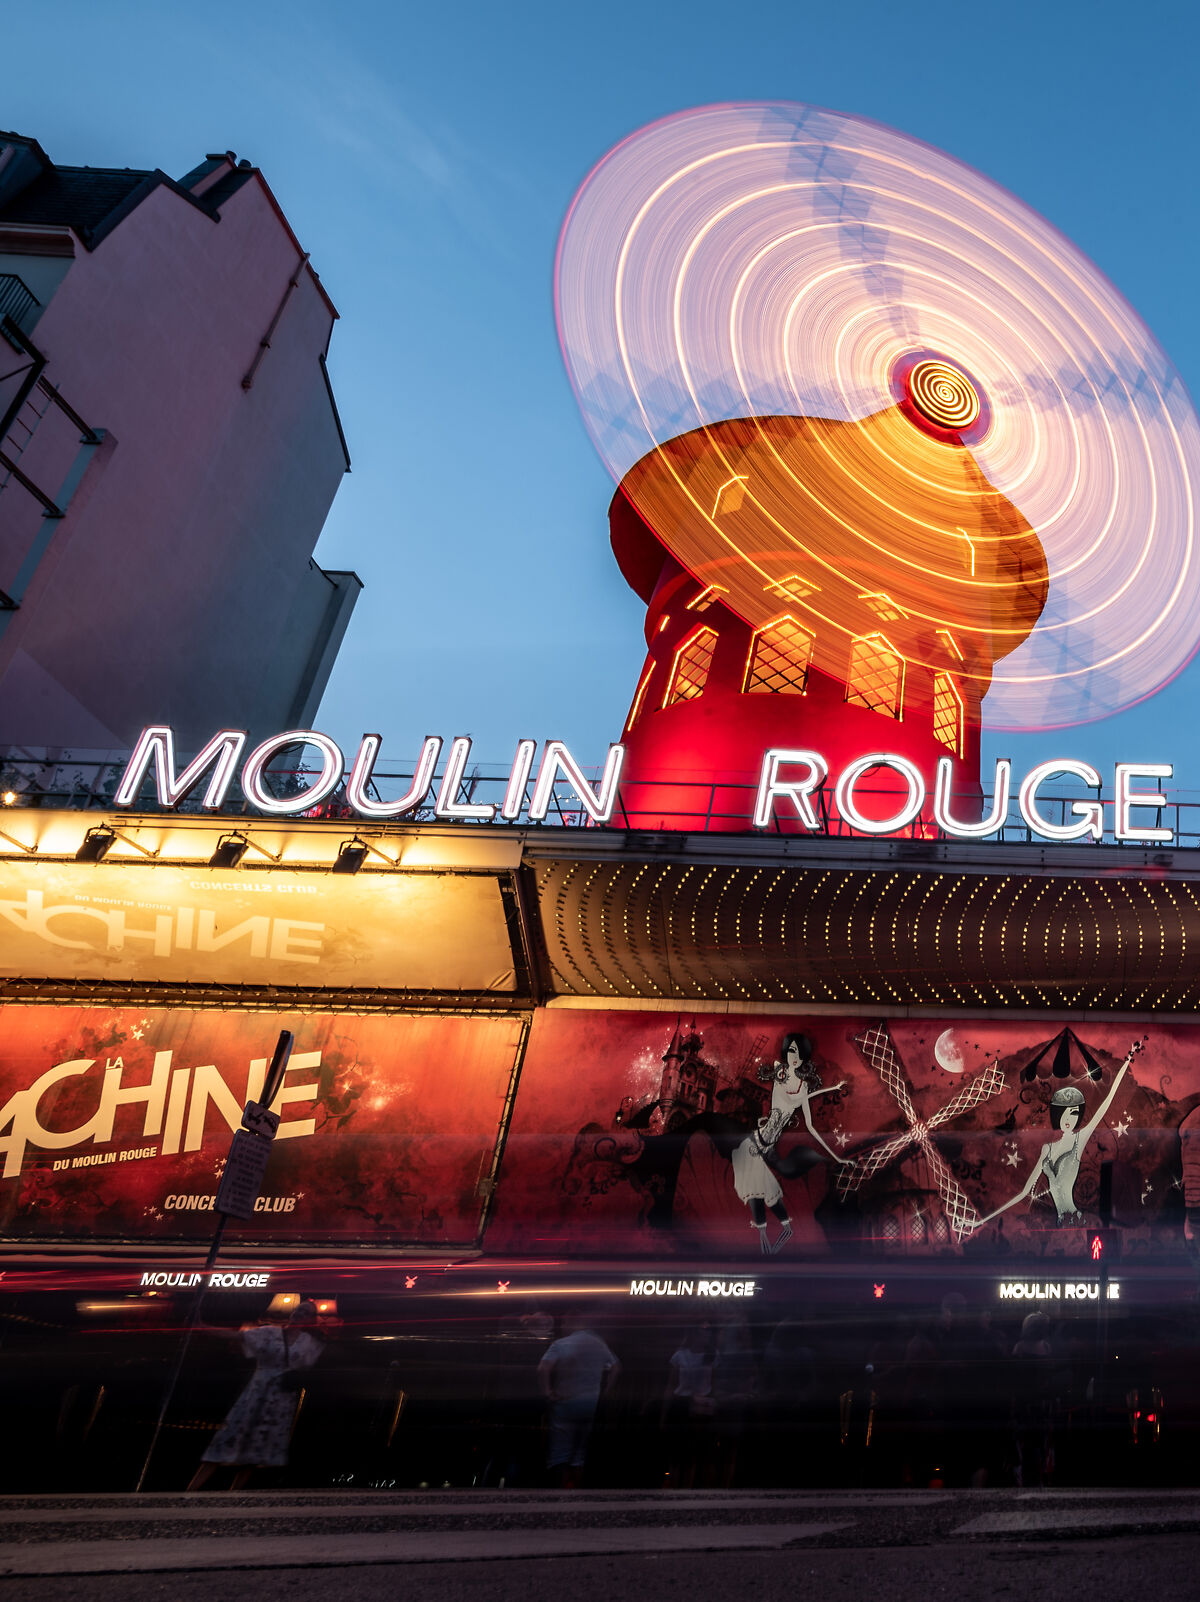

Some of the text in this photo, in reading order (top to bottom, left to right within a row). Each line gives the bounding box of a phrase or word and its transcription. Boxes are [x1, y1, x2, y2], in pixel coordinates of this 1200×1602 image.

[114, 724, 1174, 842] MOULIN ROUGE
[106, 1056, 124, 1069] LA
[53, 1147, 157, 1171] DU MOULIN ROUGE
[164, 1194, 296, 1212] CONCE CLUB
[208, 1273, 270, 1288] ROUGE
[629, 1280, 755, 1296] MOULIN ROUGE
[999, 1283, 1120, 1299] MOULIN ROUE
